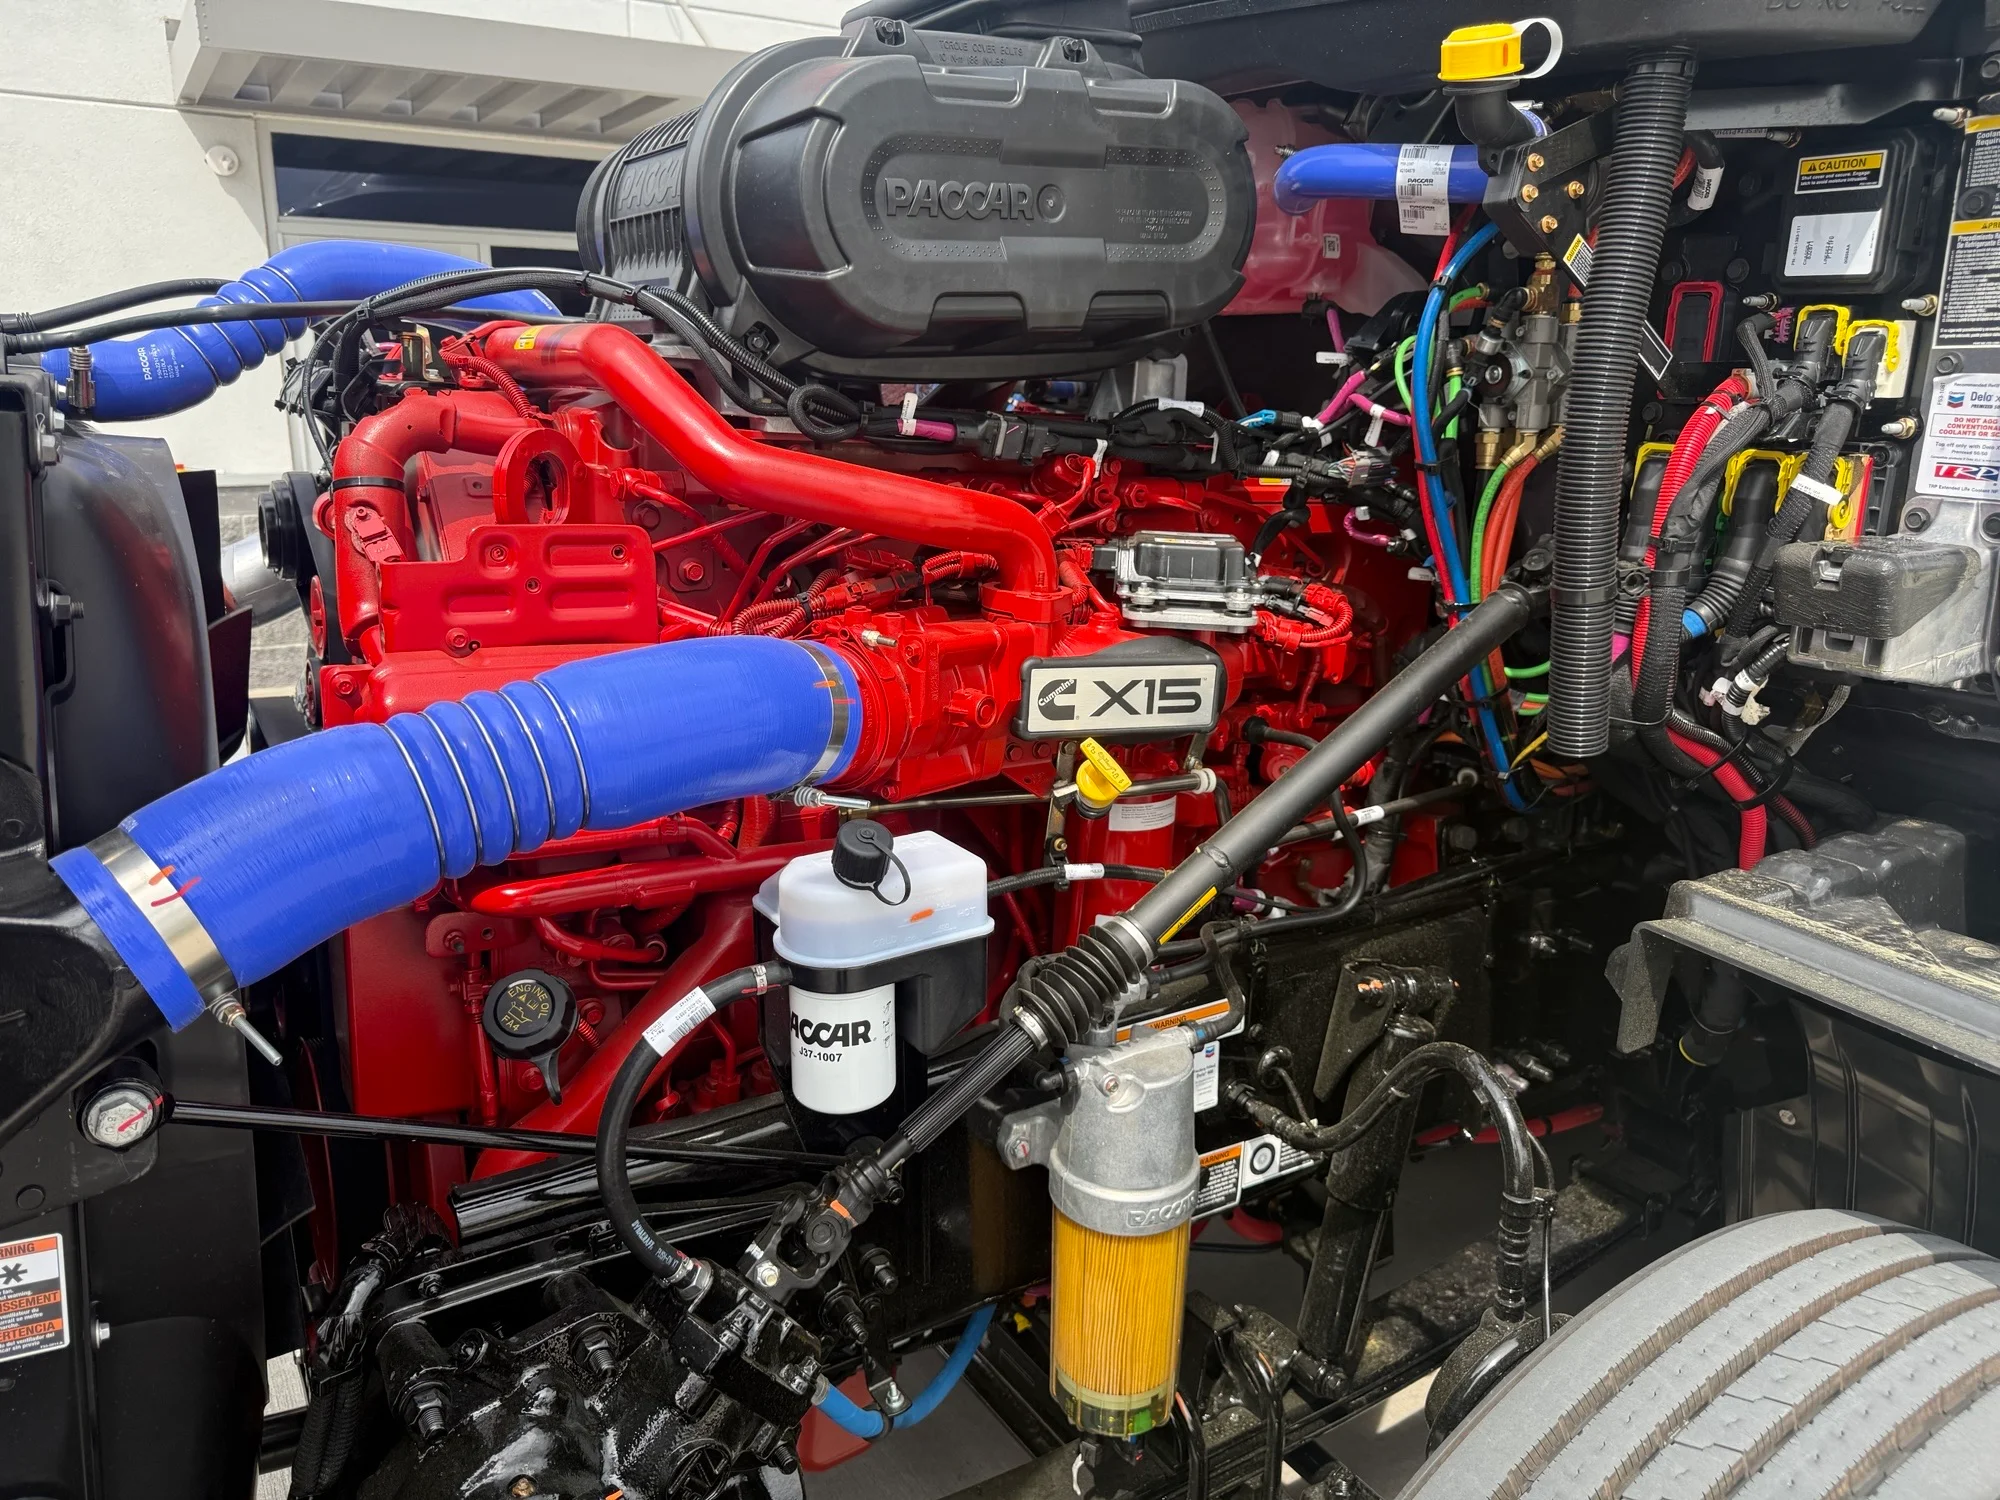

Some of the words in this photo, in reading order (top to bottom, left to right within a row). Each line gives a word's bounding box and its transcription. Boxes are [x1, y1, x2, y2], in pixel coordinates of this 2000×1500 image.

[972, 43, 996, 55] COVER
[1000, 46, 1023, 57] BOLTS
[1818, 157, 1868, 172] CAUTION
[884, 178, 1034, 220] PACCAR
[1566, 238, 1582, 262] CAUTION
[137, 346, 153, 381] PACCAR
[1971, 391, 1992, 402] Delo
[1939, 429, 1977, 437] COOLANTS
[1936, 464, 1999, 481] TRP
[1038, 678, 1075, 708] Cummins
[1089, 677, 1203, 718] X15
[958, 905, 977, 918] HOT
[1183, 903, 1202, 922] CAUTION
[507, 984, 548, 1001] ENGINE
[537, 1002, 550, 1019] OIL
[501, 1014, 520, 1031] FA4
[1154, 1015, 1187, 1030] WARNING
[799, 1047, 843, 1062] J37-1007
[7, 1290, 33, 1299] warning.
[24, 1312, 43, 1320] mettre
[16, 1334, 45, 1344] ventilador
[22, 1341, 40, 1349] previo
